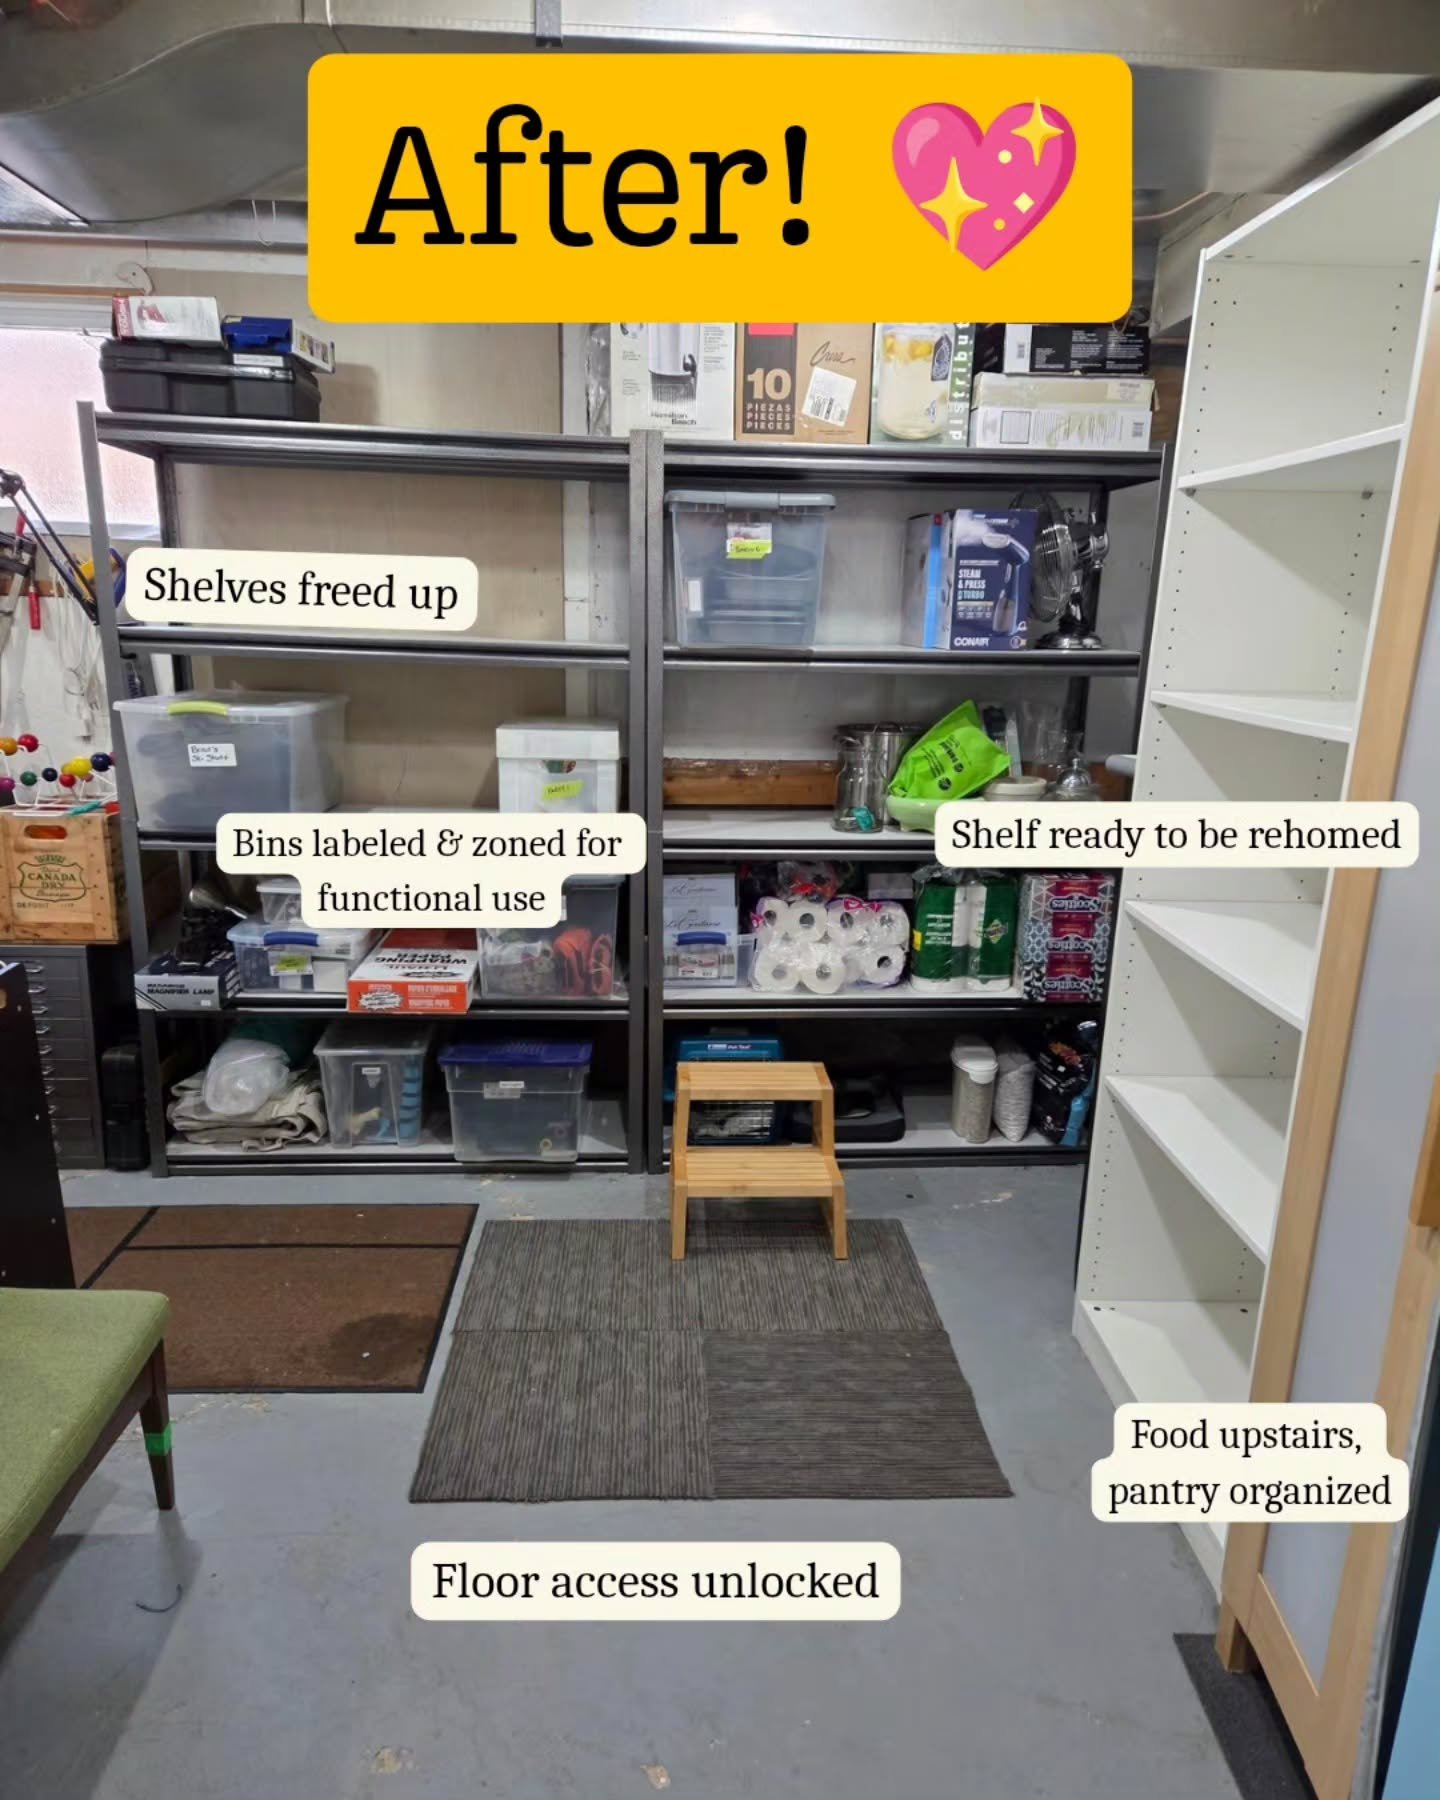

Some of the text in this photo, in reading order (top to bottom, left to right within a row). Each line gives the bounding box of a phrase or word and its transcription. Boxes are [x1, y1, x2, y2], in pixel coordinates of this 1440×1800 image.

[747, 367, 792, 400] 10
[746, 402, 791, 412] PIEZAS
[958, 569, 981, 578] STEAM
[965, 580, 986, 589] PRESS
[954, 637, 990, 647] CONAIR
[27, 872, 77, 881] CANADA
[41, 881, 65, 889] DRY
